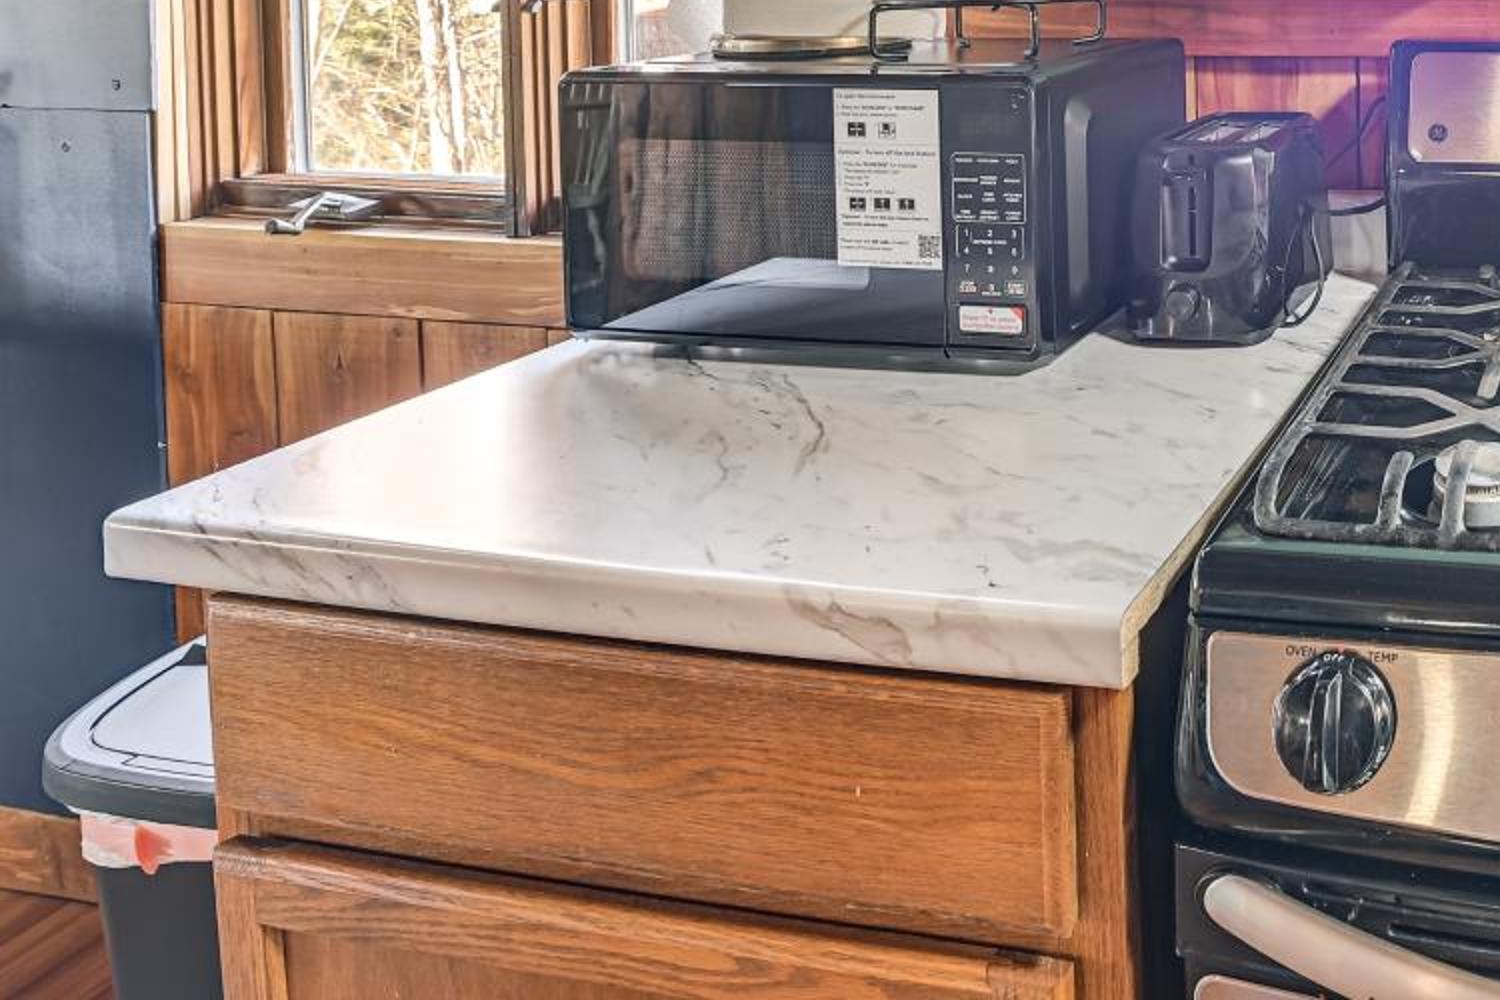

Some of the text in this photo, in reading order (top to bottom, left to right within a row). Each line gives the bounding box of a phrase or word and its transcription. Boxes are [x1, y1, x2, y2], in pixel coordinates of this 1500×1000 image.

[1285, 646, 1399, 662] OVEN TEMP
[1323, 653, 1346, 663] OFF
